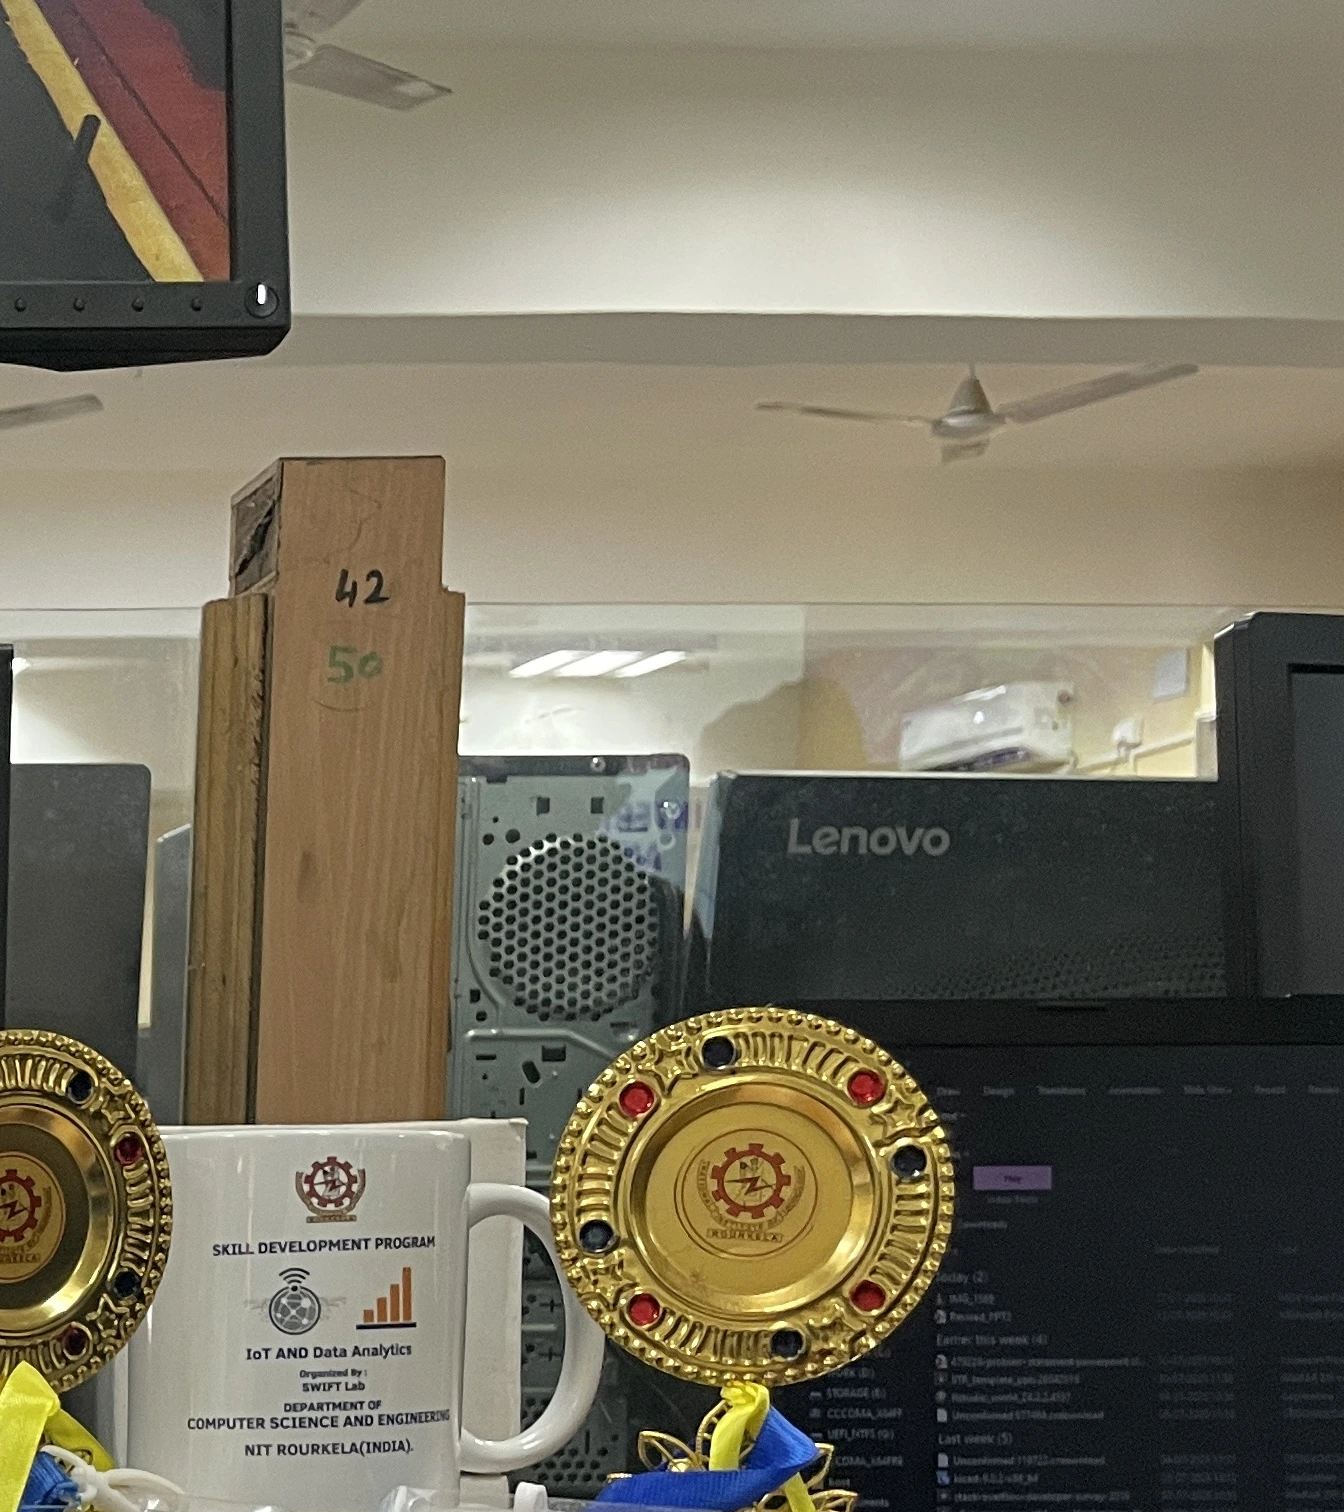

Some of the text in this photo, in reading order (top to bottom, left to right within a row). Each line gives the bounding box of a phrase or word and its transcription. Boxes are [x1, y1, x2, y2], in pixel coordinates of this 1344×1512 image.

[336, 569, 391, 607] 42
[326, 644, 383, 684] 50
[788, 818, 949, 856] Lenovo
[212, 1235, 436, 1257] SKILL DEVELOPMENT PROGRAM
[246, 1343, 413, 1361] IoT AND Data Analytics
[299, 1368, 363, 1382] Organized By
[302, 1381, 365, 1393] SWIFT Lab
[283, 1400, 382, 1413] DEPARTMENT OF
[187, 1409, 451, 1431] COMPUTER SCIENCE AND ENGINEERING
[244, 1443, 273, 1457] NIT
